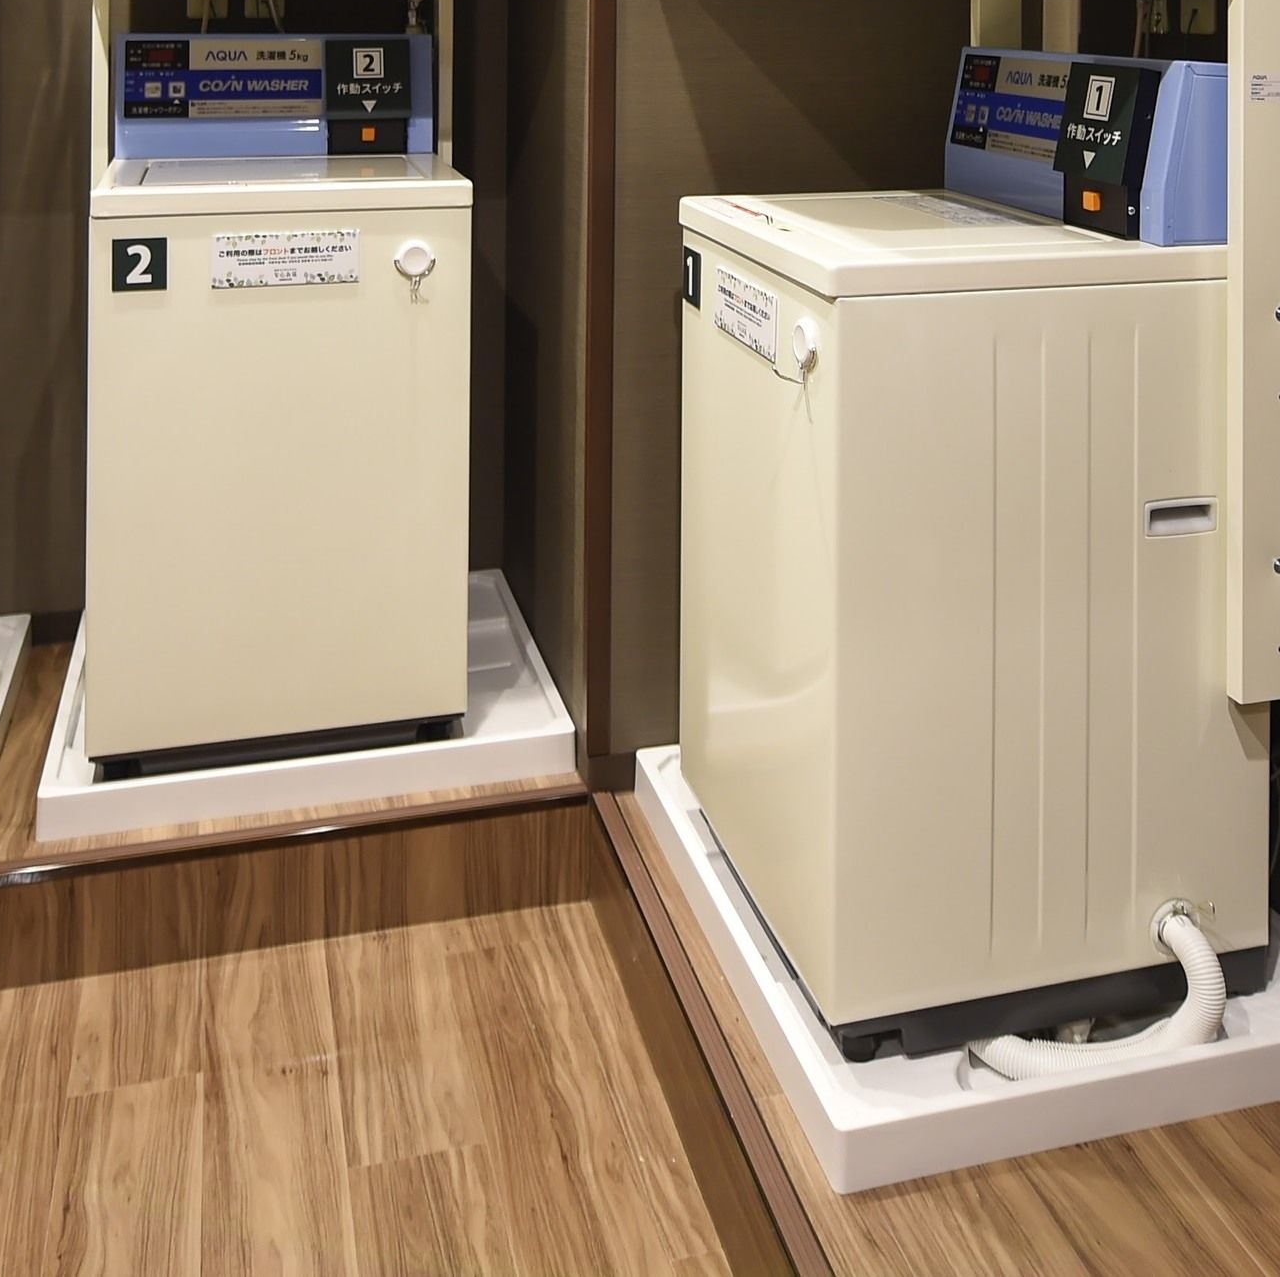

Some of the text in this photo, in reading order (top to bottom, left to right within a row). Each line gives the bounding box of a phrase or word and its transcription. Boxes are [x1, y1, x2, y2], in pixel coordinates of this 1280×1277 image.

[204, 50, 248, 62] AQUA
[362, 54, 375, 72] 2
[247, 80, 309, 92] WASHER
[1005, 70, 1033, 87] AQUA
[336, 82, 403, 95] 作動スイッチ
[1095, 84, 1104, 111] 1
[1066, 122, 1122, 146] 作動スイッチ
[125, 244, 153, 285] 2
[686, 255, 693, 297] 1
